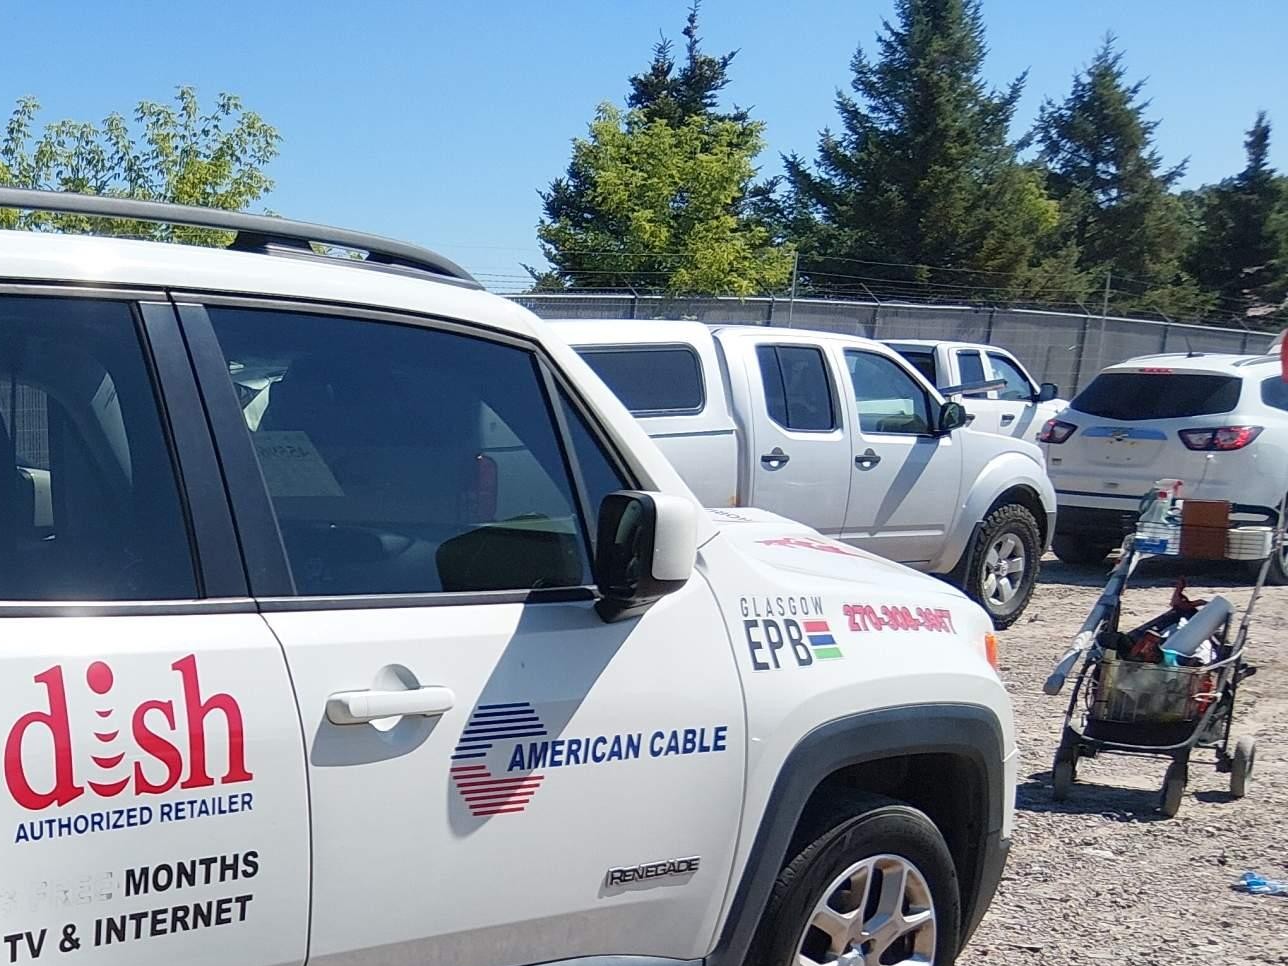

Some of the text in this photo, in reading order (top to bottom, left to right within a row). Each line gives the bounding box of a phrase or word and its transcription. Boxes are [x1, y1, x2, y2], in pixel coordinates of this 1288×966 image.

[740, 596, 824, 618] GLASGOW
[743, 618, 813, 671] EPB
[4, 654, 254, 811] dish
[508, 726, 728, 772] AMERICAN CABLE
[15, 792, 254, 843] AUTHORIZED RETAILER
[125, 850, 260, 897] MONTHS
[607, 857, 700, 887] RENEGADE
[3, 894, 254, 964] TV & INTERNET
